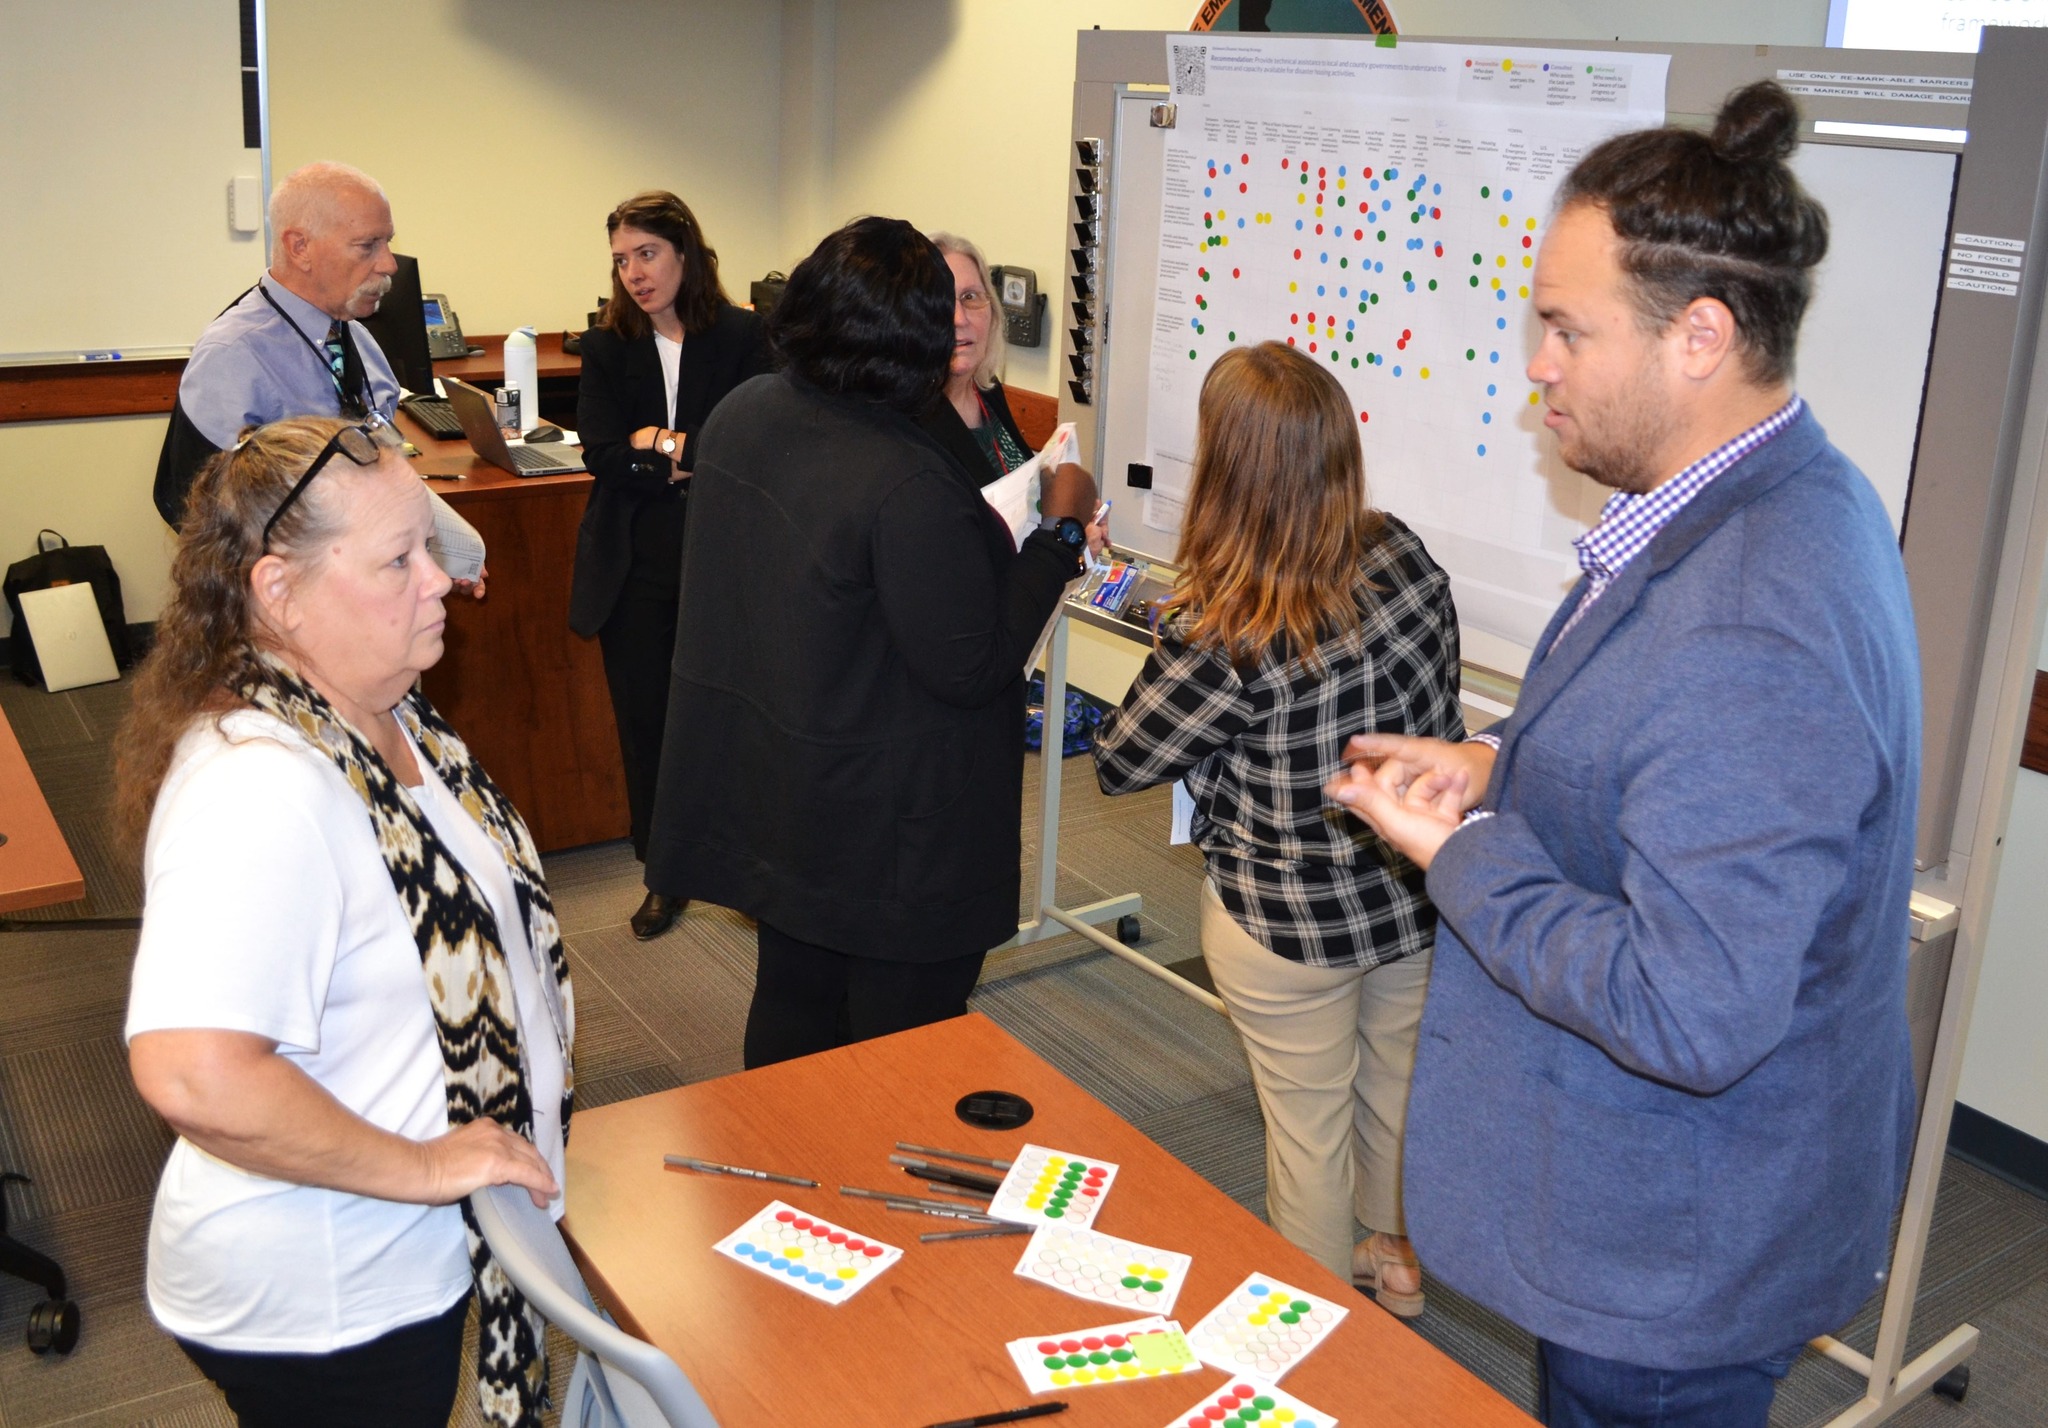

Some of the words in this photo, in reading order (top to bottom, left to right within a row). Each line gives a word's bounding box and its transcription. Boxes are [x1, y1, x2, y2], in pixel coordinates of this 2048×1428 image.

[1255, 56, 1272, 64] Provide
[1891, 92, 1934, 100] DAMAGE
[1978, 255, 2014, 264] FORCE
[1980, 270, 2010, 278] HOLD
